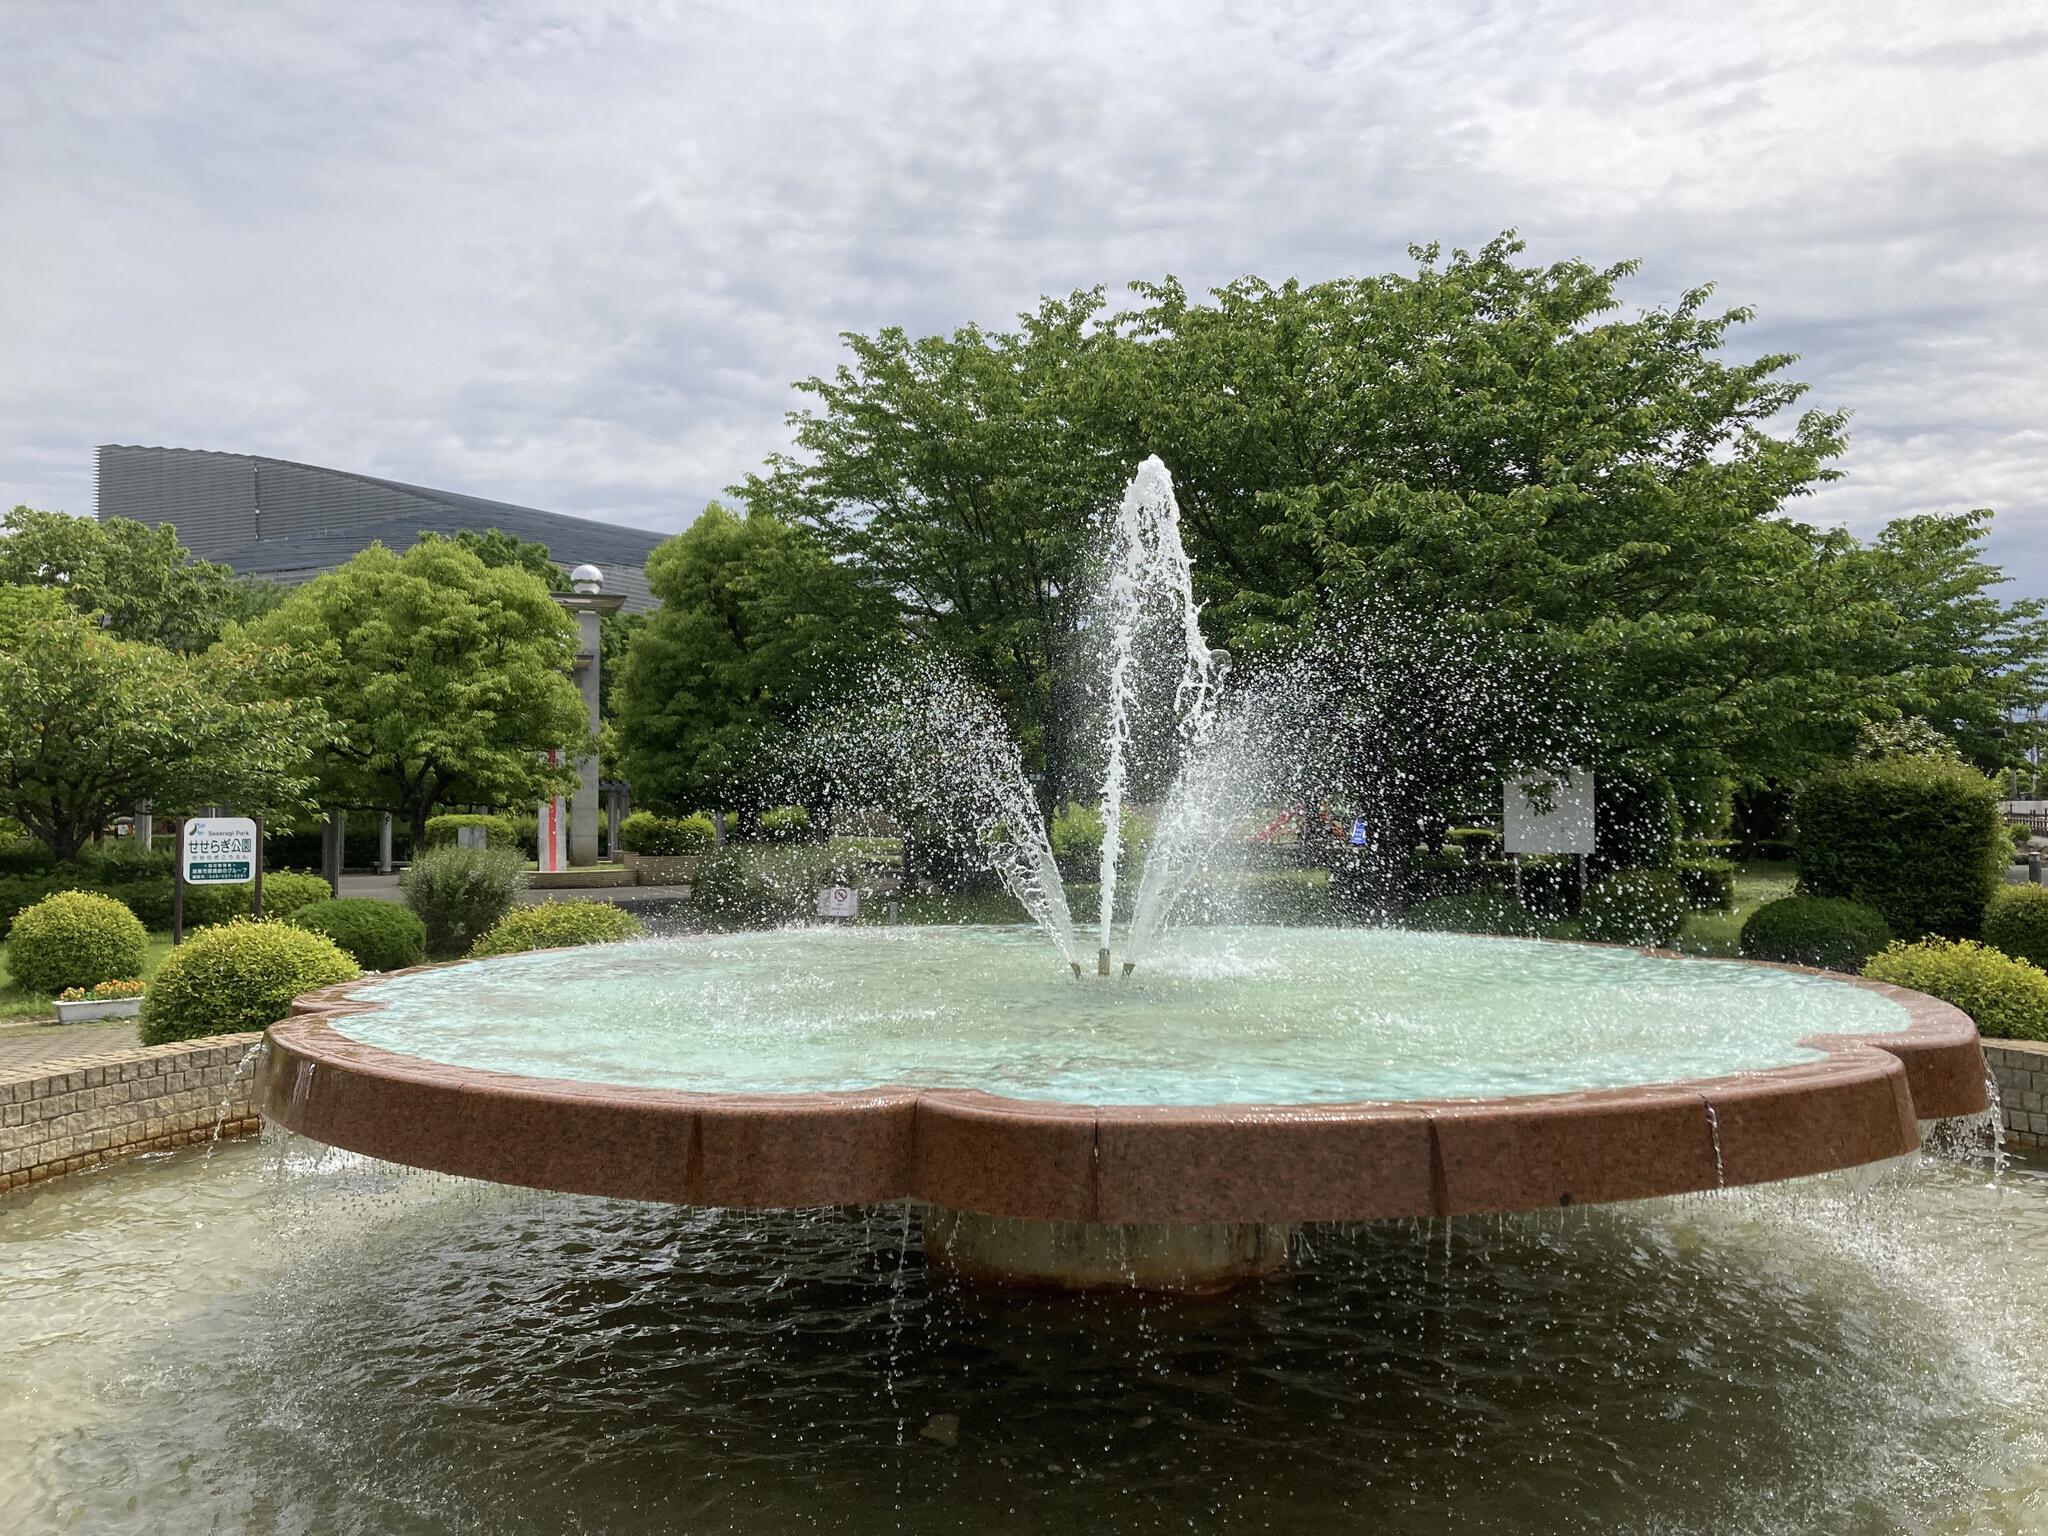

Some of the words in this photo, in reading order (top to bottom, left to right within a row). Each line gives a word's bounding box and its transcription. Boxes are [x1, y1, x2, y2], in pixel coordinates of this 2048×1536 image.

[189, 839, 251, 853] せせらぎ公園
